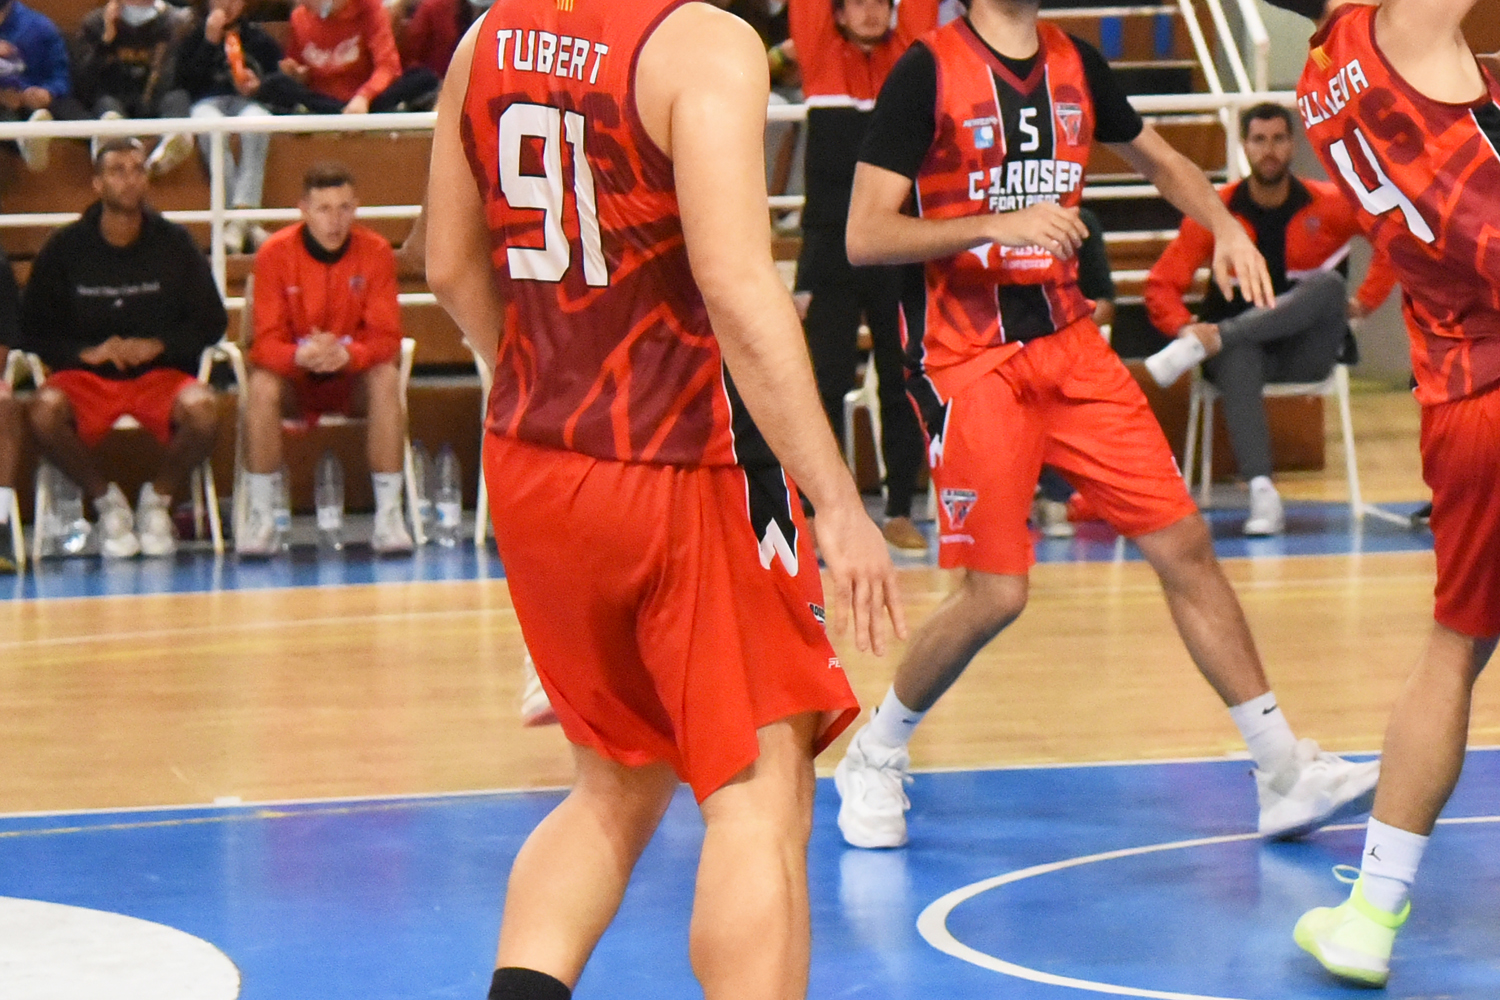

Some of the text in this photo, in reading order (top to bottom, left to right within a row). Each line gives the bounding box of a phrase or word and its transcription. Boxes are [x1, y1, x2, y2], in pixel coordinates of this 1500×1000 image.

[496, 28, 609, 85] TUBERT
[1018, 106, 1040, 153] 5
[498, 101, 610, 288] 91
[1328, 126, 1437, 245] 4
